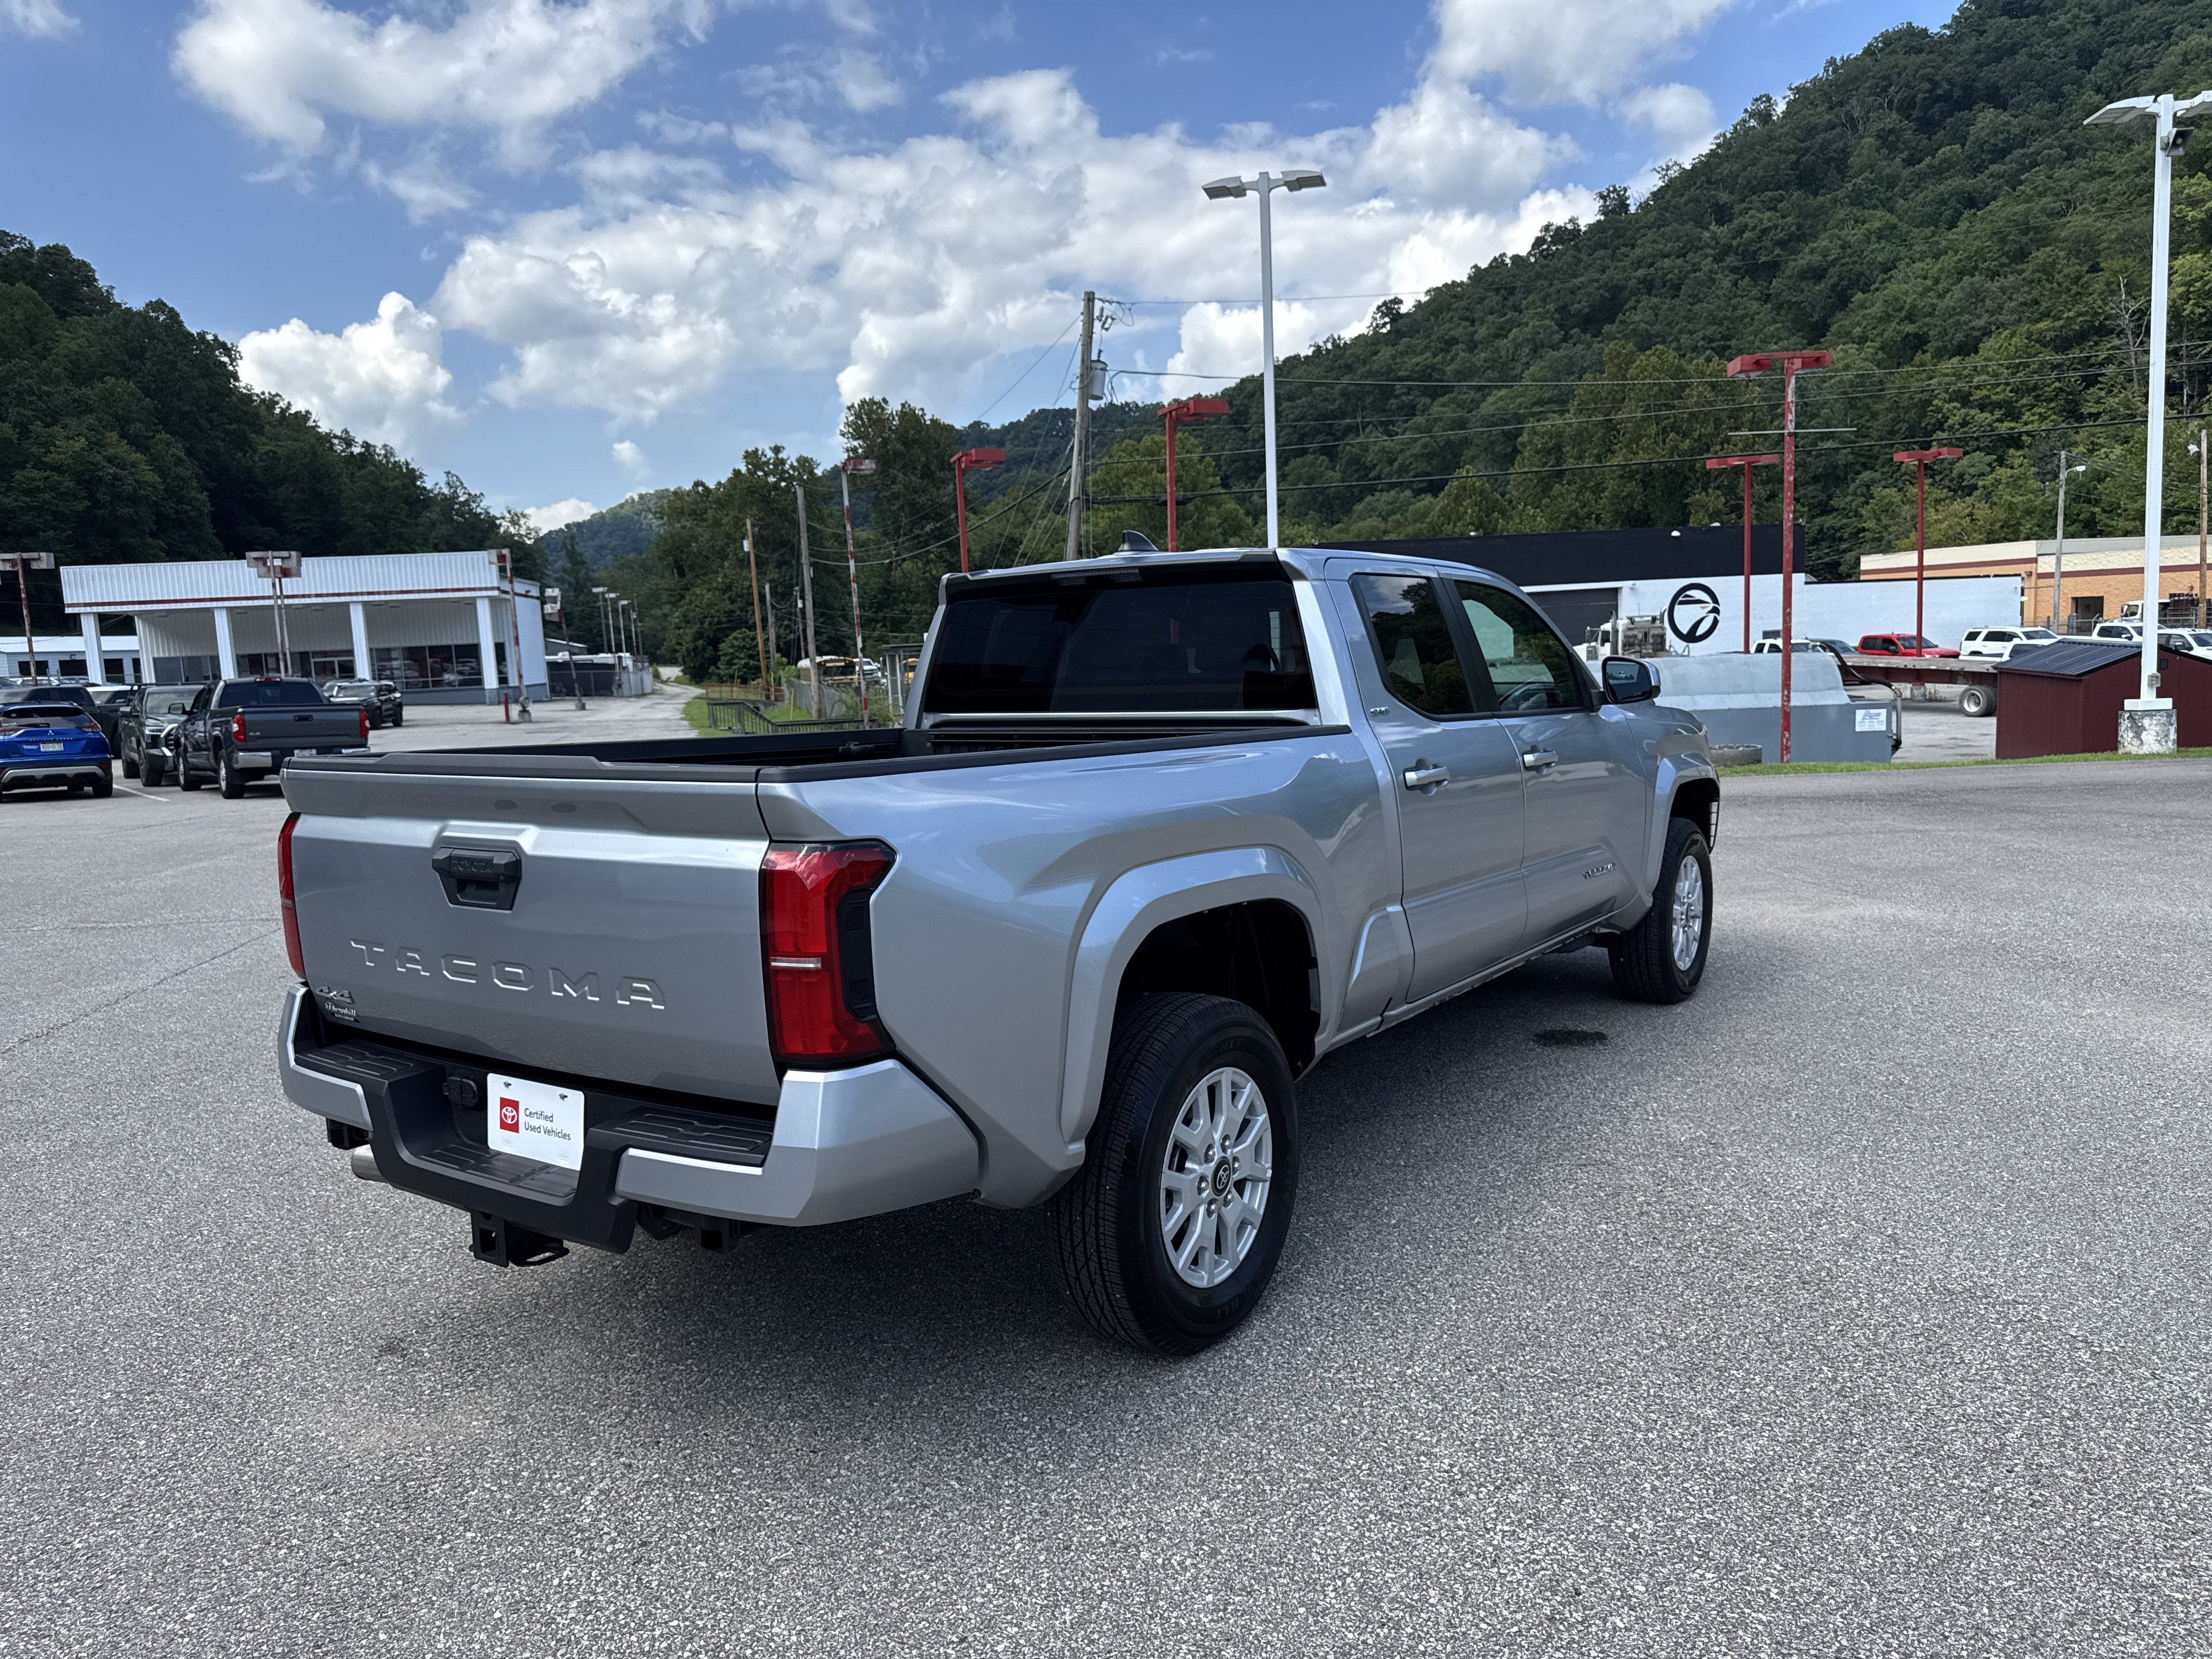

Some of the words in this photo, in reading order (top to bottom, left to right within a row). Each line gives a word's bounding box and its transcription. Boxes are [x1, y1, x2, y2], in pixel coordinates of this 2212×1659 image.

[350, 939, 665, 1009] TACOMA
[524, 1108, 554, 1122] Certified
[524, 1121, 541, 1133] Used
[543, 1125, 571, 1141] Vehicles
